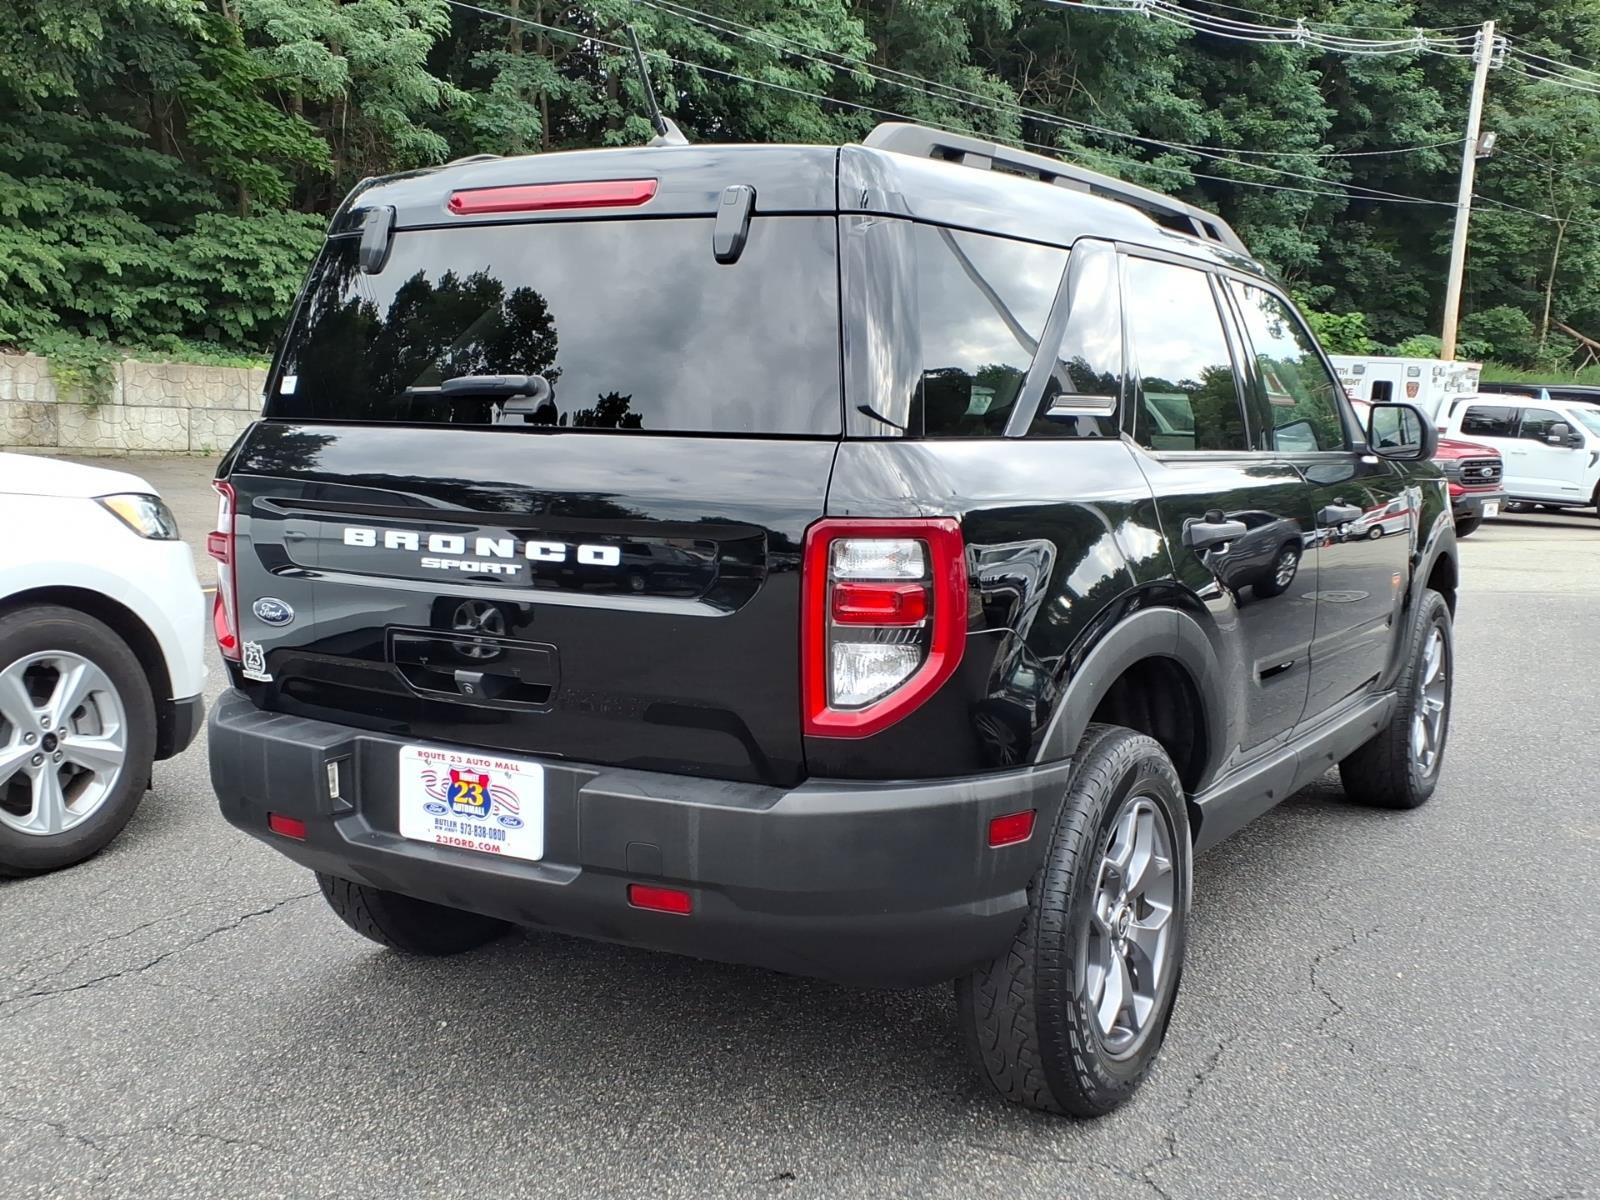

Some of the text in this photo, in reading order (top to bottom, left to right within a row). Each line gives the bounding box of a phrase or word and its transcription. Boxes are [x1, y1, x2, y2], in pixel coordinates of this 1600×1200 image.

[343, 527, 621, 566] BRONCO
[420, 557, 522, 575] SPORT
[247, 651, 261, 666] 23
[417, 750, 521, 771] ROUTE 23 AUTO MALL
[453, 781, 484, 806] 23
[434, 817, 458, 828] BUTLER
[460, 821, 506, 841] 973-838-0800
[435, 834, 501, 852] 23FORD.COM
